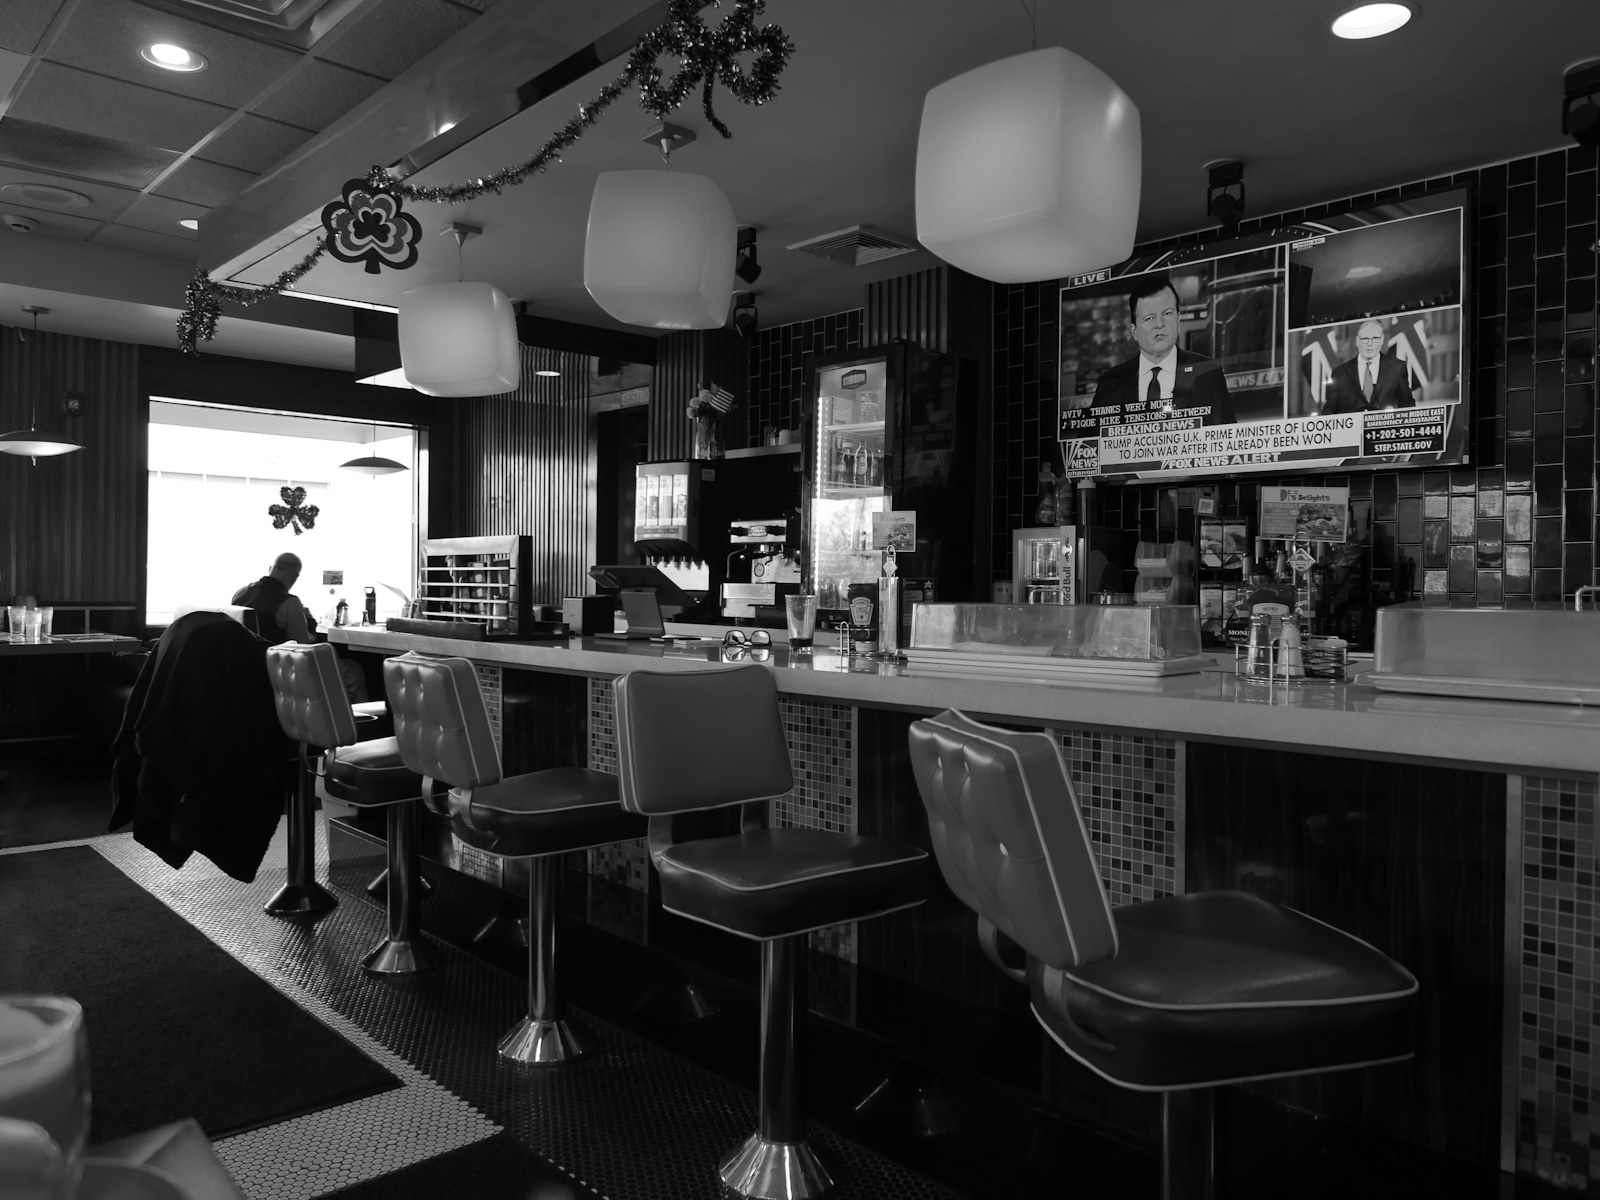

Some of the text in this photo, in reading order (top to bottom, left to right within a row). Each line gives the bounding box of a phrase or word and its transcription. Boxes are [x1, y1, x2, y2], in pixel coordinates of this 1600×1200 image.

[1074, 272, 1106, 286] LIVE
[1062, 409, 1086, 419] AVIV,
[1090, 405, 1121, 416] THANKS
[1125, 402, 1147, 412] VERY
[1070, 405, 1213, 429] PIQUE MIKE TENSIONS BETWEEN
[1364, 412, 1395, 422] AMERICANS
[1409, 409, 1431, 418] MIDDLE
[1430, 408, 1444, 416] EAST
[1108, 419, 1195, 437] BREAKING NEWS
[1367, 416, 1441, 427] EMERGENCY ASSISTANCE
[1103, 417, 1354, 450] TRUMP ACCUSING U.K. PRIME MINISTER OF LOOKING
[1365, 425, 1442, 440] +1-202-501-4444
[1077, 446, 1098, 459] FOX
[1119, 432, 1332, 459] TO JOIN WAR AFTER ITS ALREADY BEEN WON
[1374, 440, 1433, 453] STEP.STATE.GOV
[1071, 457, 1098, 469] NEWS
[1168, 451, 1282, 469] FOX NEWS ALERT
[1067, 469, 1098, 477] channel
[1298, 494, 1331, 503] Delights
[1062, 566, 1071, 585] Bull
